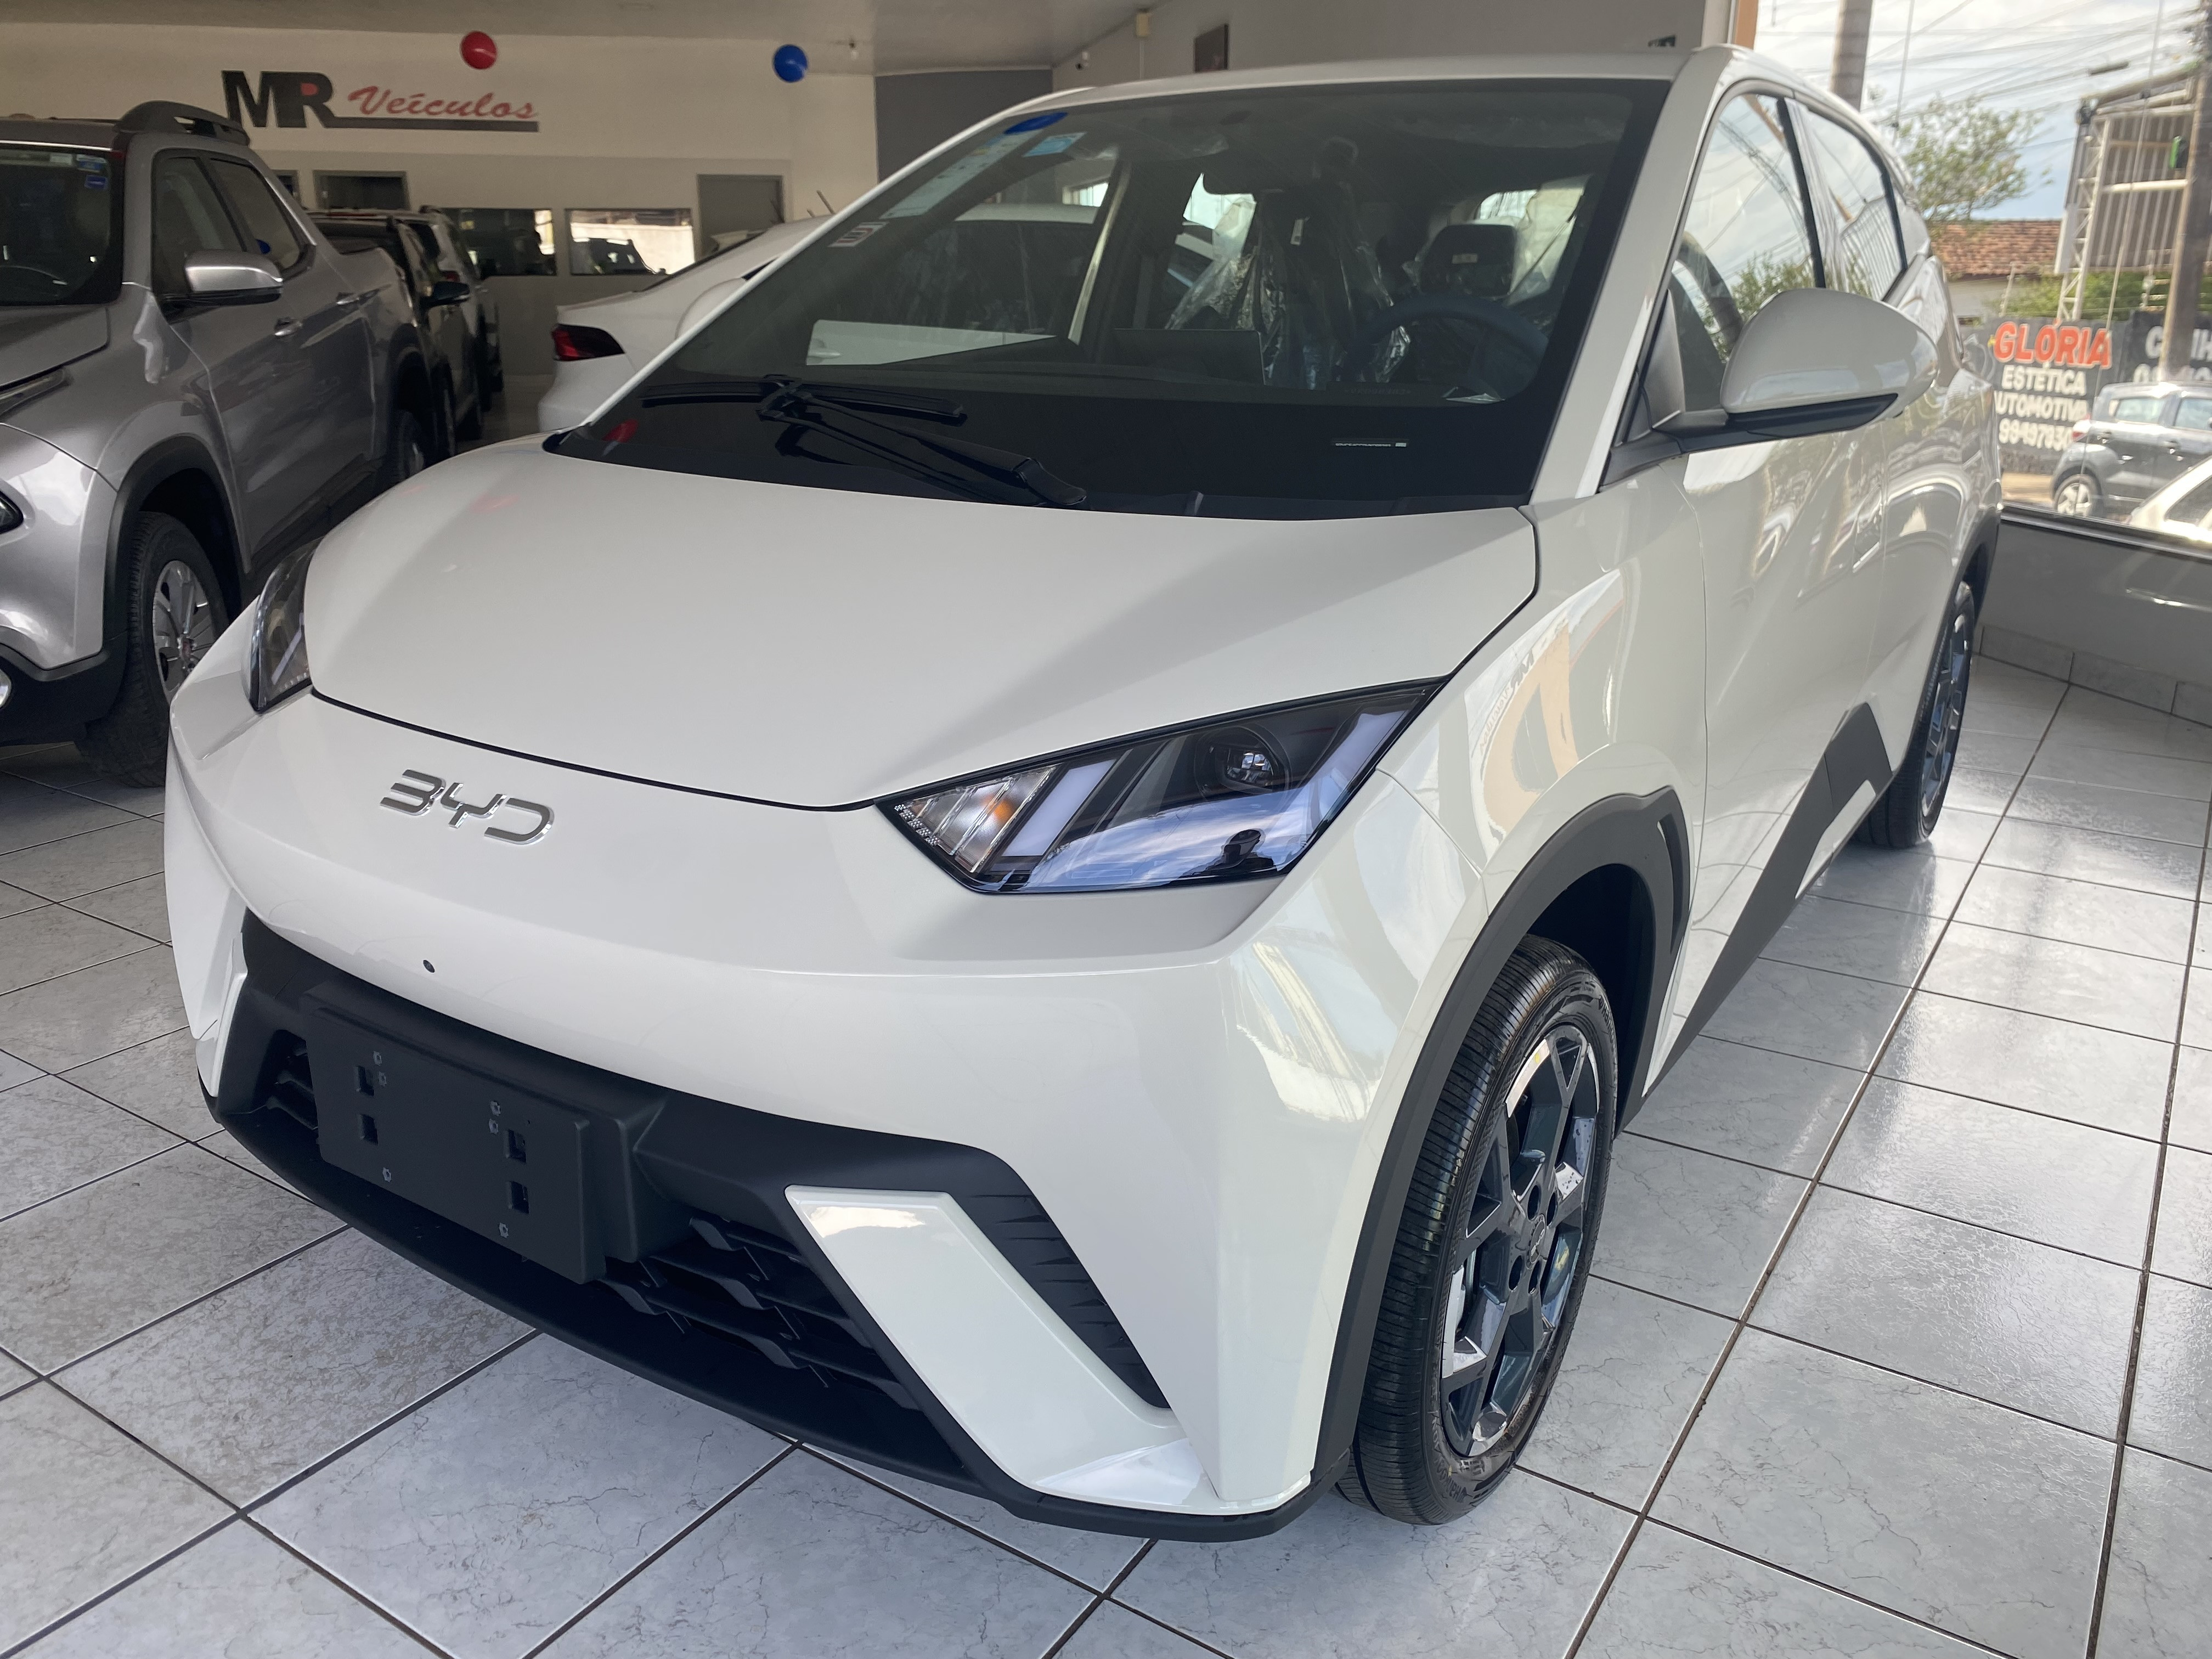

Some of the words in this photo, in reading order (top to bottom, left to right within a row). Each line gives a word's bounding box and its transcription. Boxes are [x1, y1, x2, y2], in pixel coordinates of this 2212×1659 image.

[221, 70, 335, 128] MR
[347, 86, 538, 119] Veículos
[1994, 390, 2089, 422] UTOMOTIVA
[380, 769, 554, 845] BYD
